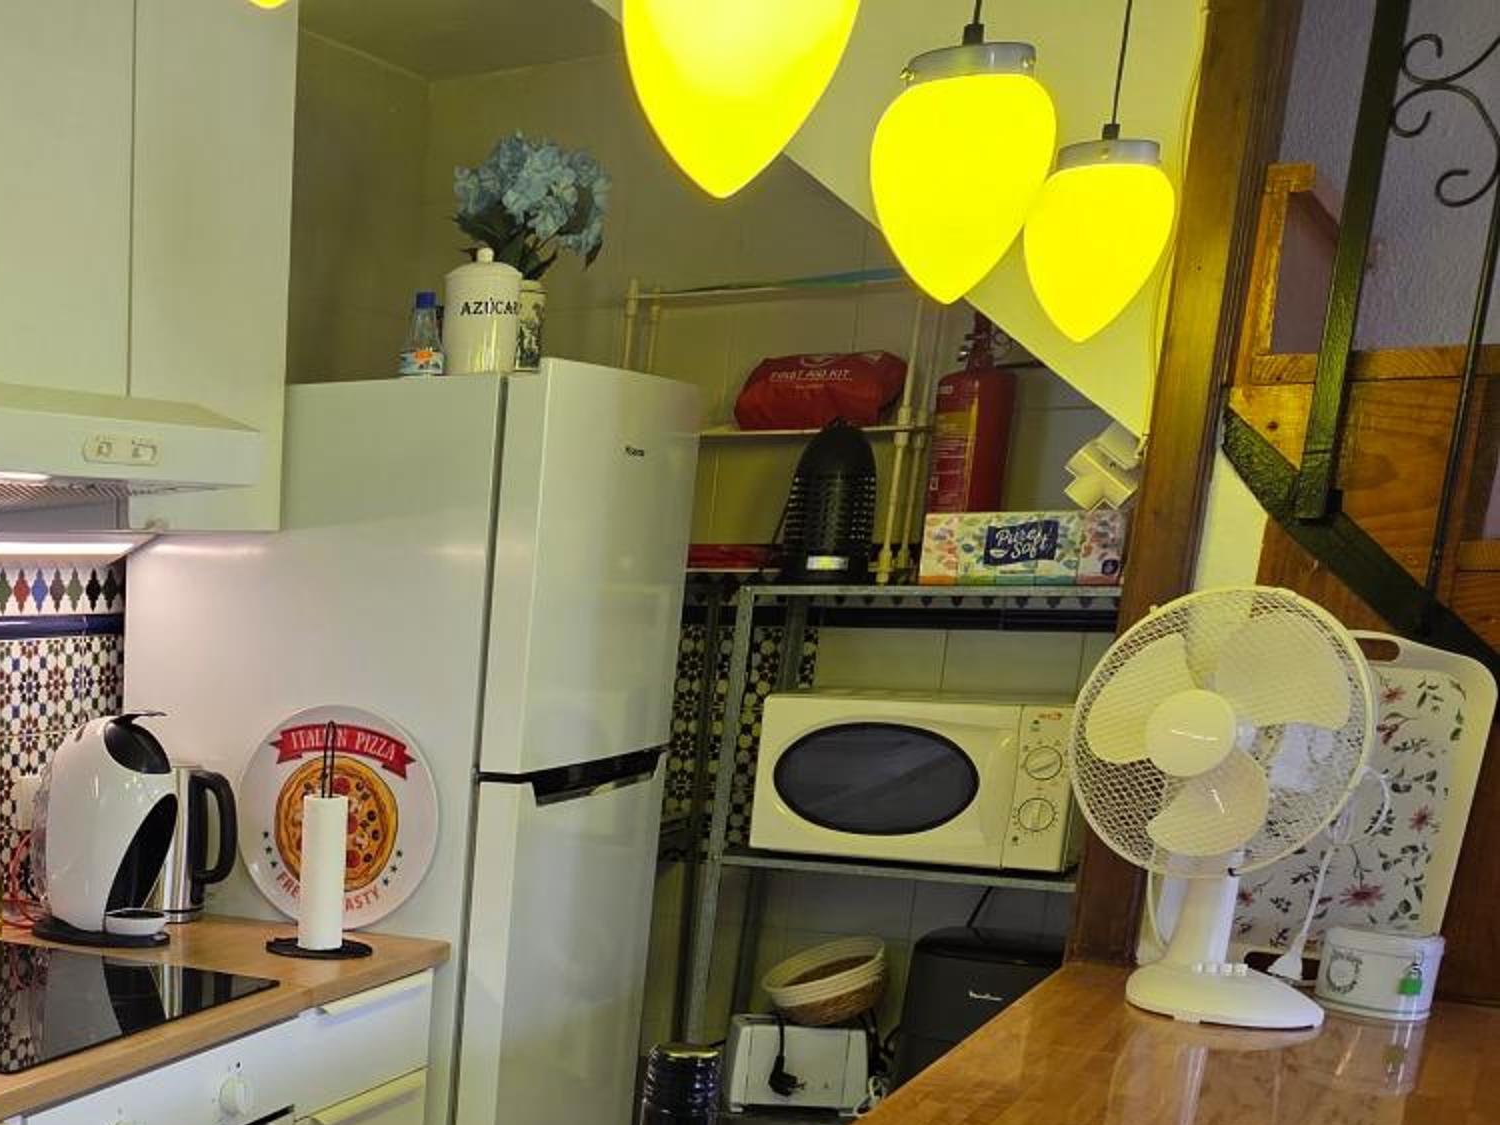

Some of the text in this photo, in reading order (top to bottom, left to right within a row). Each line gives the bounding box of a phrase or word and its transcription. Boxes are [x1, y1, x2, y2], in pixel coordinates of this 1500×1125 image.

[291, 727, 397, 760] ITALIN PIZZA
[344, 884, 380, 912] ASTY
